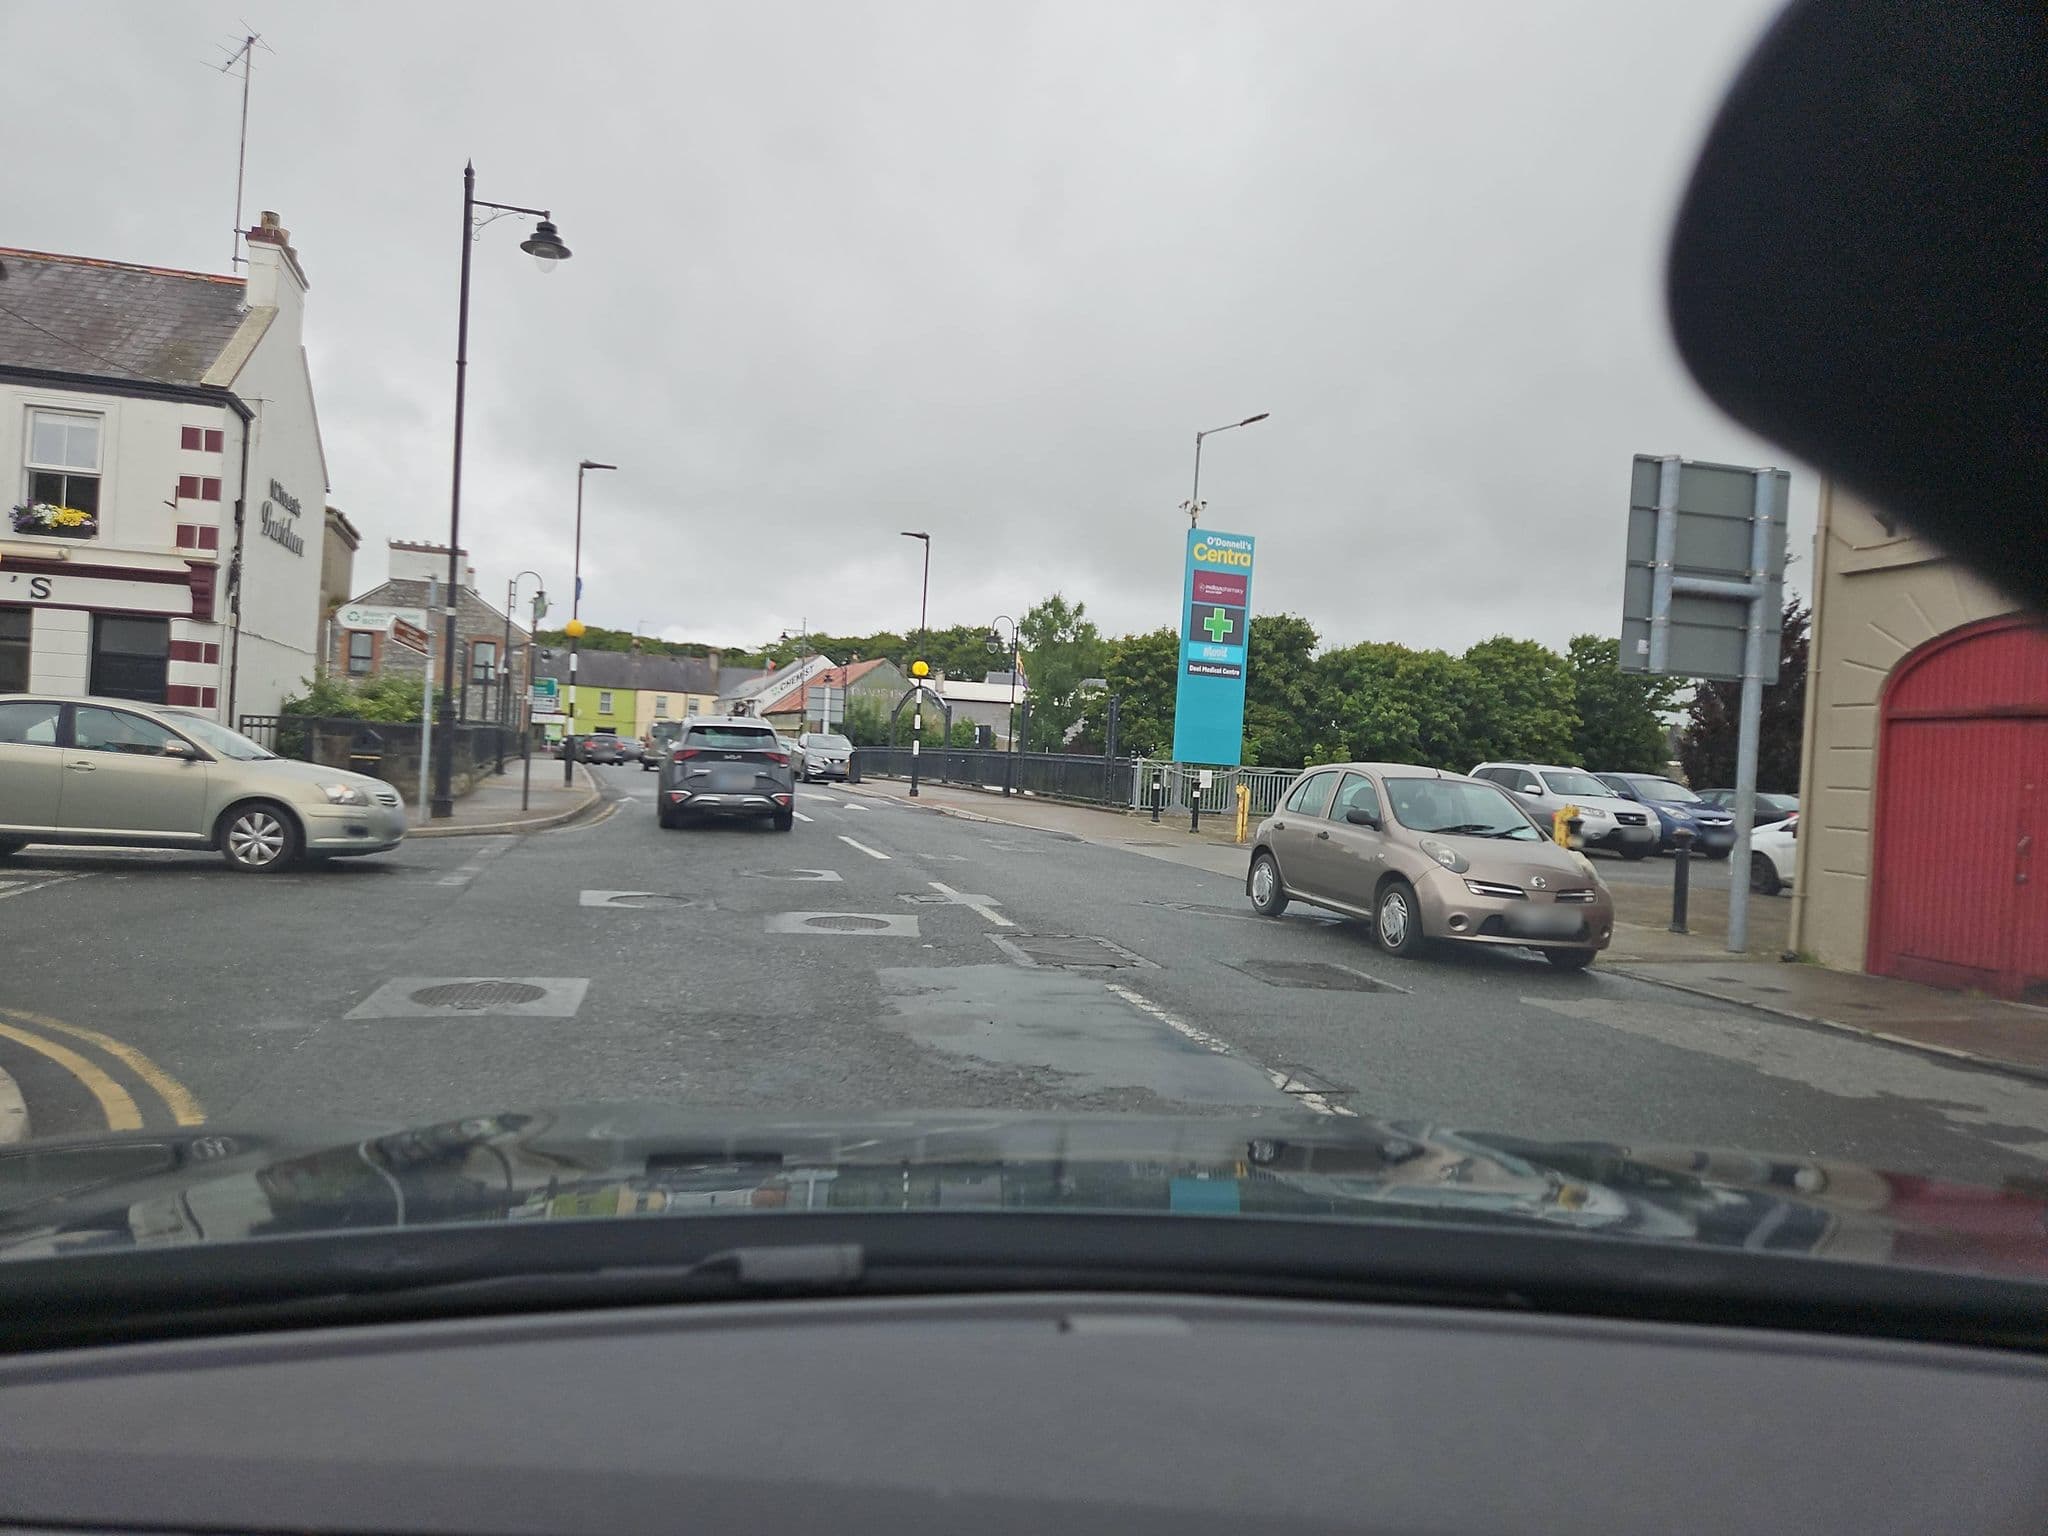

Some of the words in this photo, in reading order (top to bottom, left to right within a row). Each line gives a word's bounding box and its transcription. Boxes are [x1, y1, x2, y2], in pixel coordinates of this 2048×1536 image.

[1207, 536, 1252, 550] O'Donnell's
[1193, 543, 1251, 567] Centra
[780, 663, 815, 691] CHEMST
[1202, 666, 1222, 674] Medical
[1222, 668, 1240, 676] Centre
